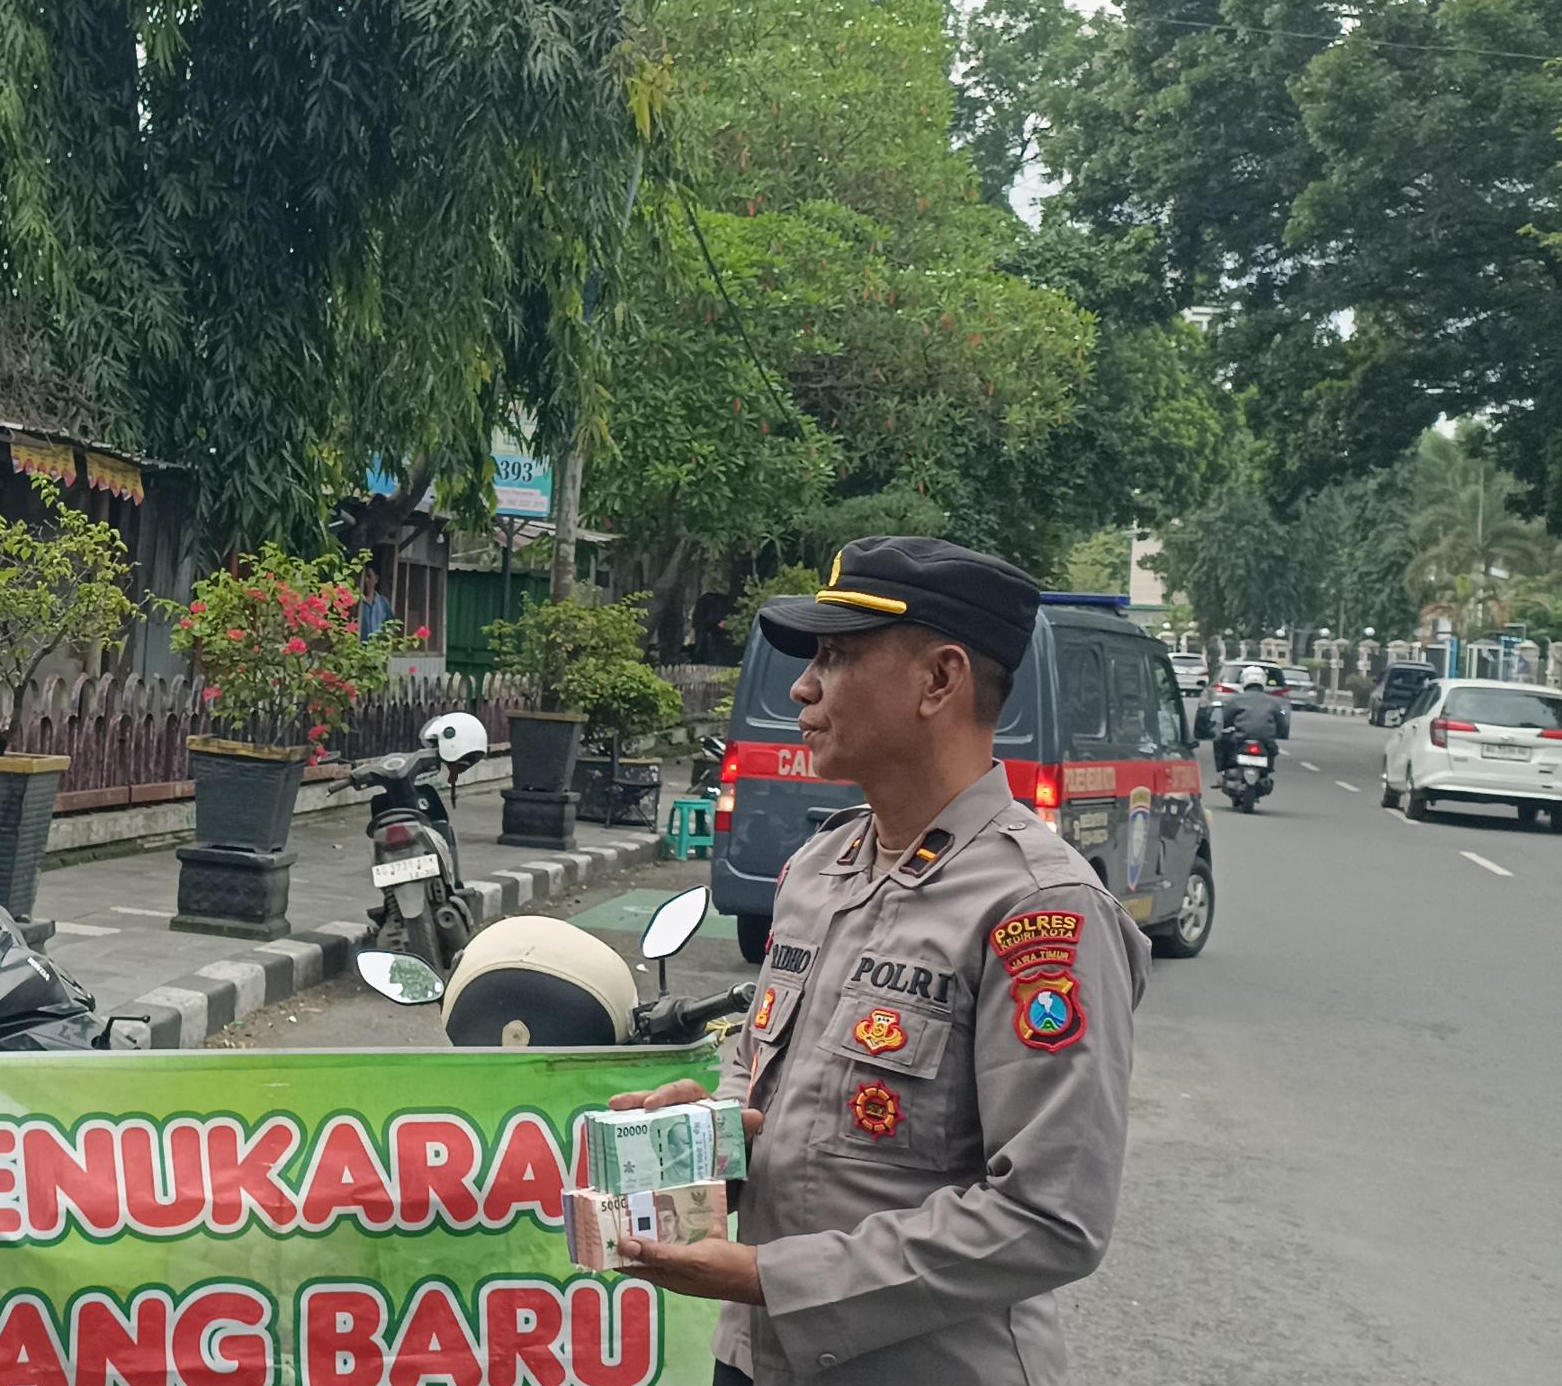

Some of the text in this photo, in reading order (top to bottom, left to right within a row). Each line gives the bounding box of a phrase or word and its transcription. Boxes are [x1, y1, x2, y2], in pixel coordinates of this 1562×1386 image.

[995, 915, 1077, 944] POLRES
[1040, 928, 1074, 939] KOTA
[1039, 949, 1070, 961] TIMUR
[852, 957, 953, 1004] POLRI
[617, 1124, 648, 1138] 20000
